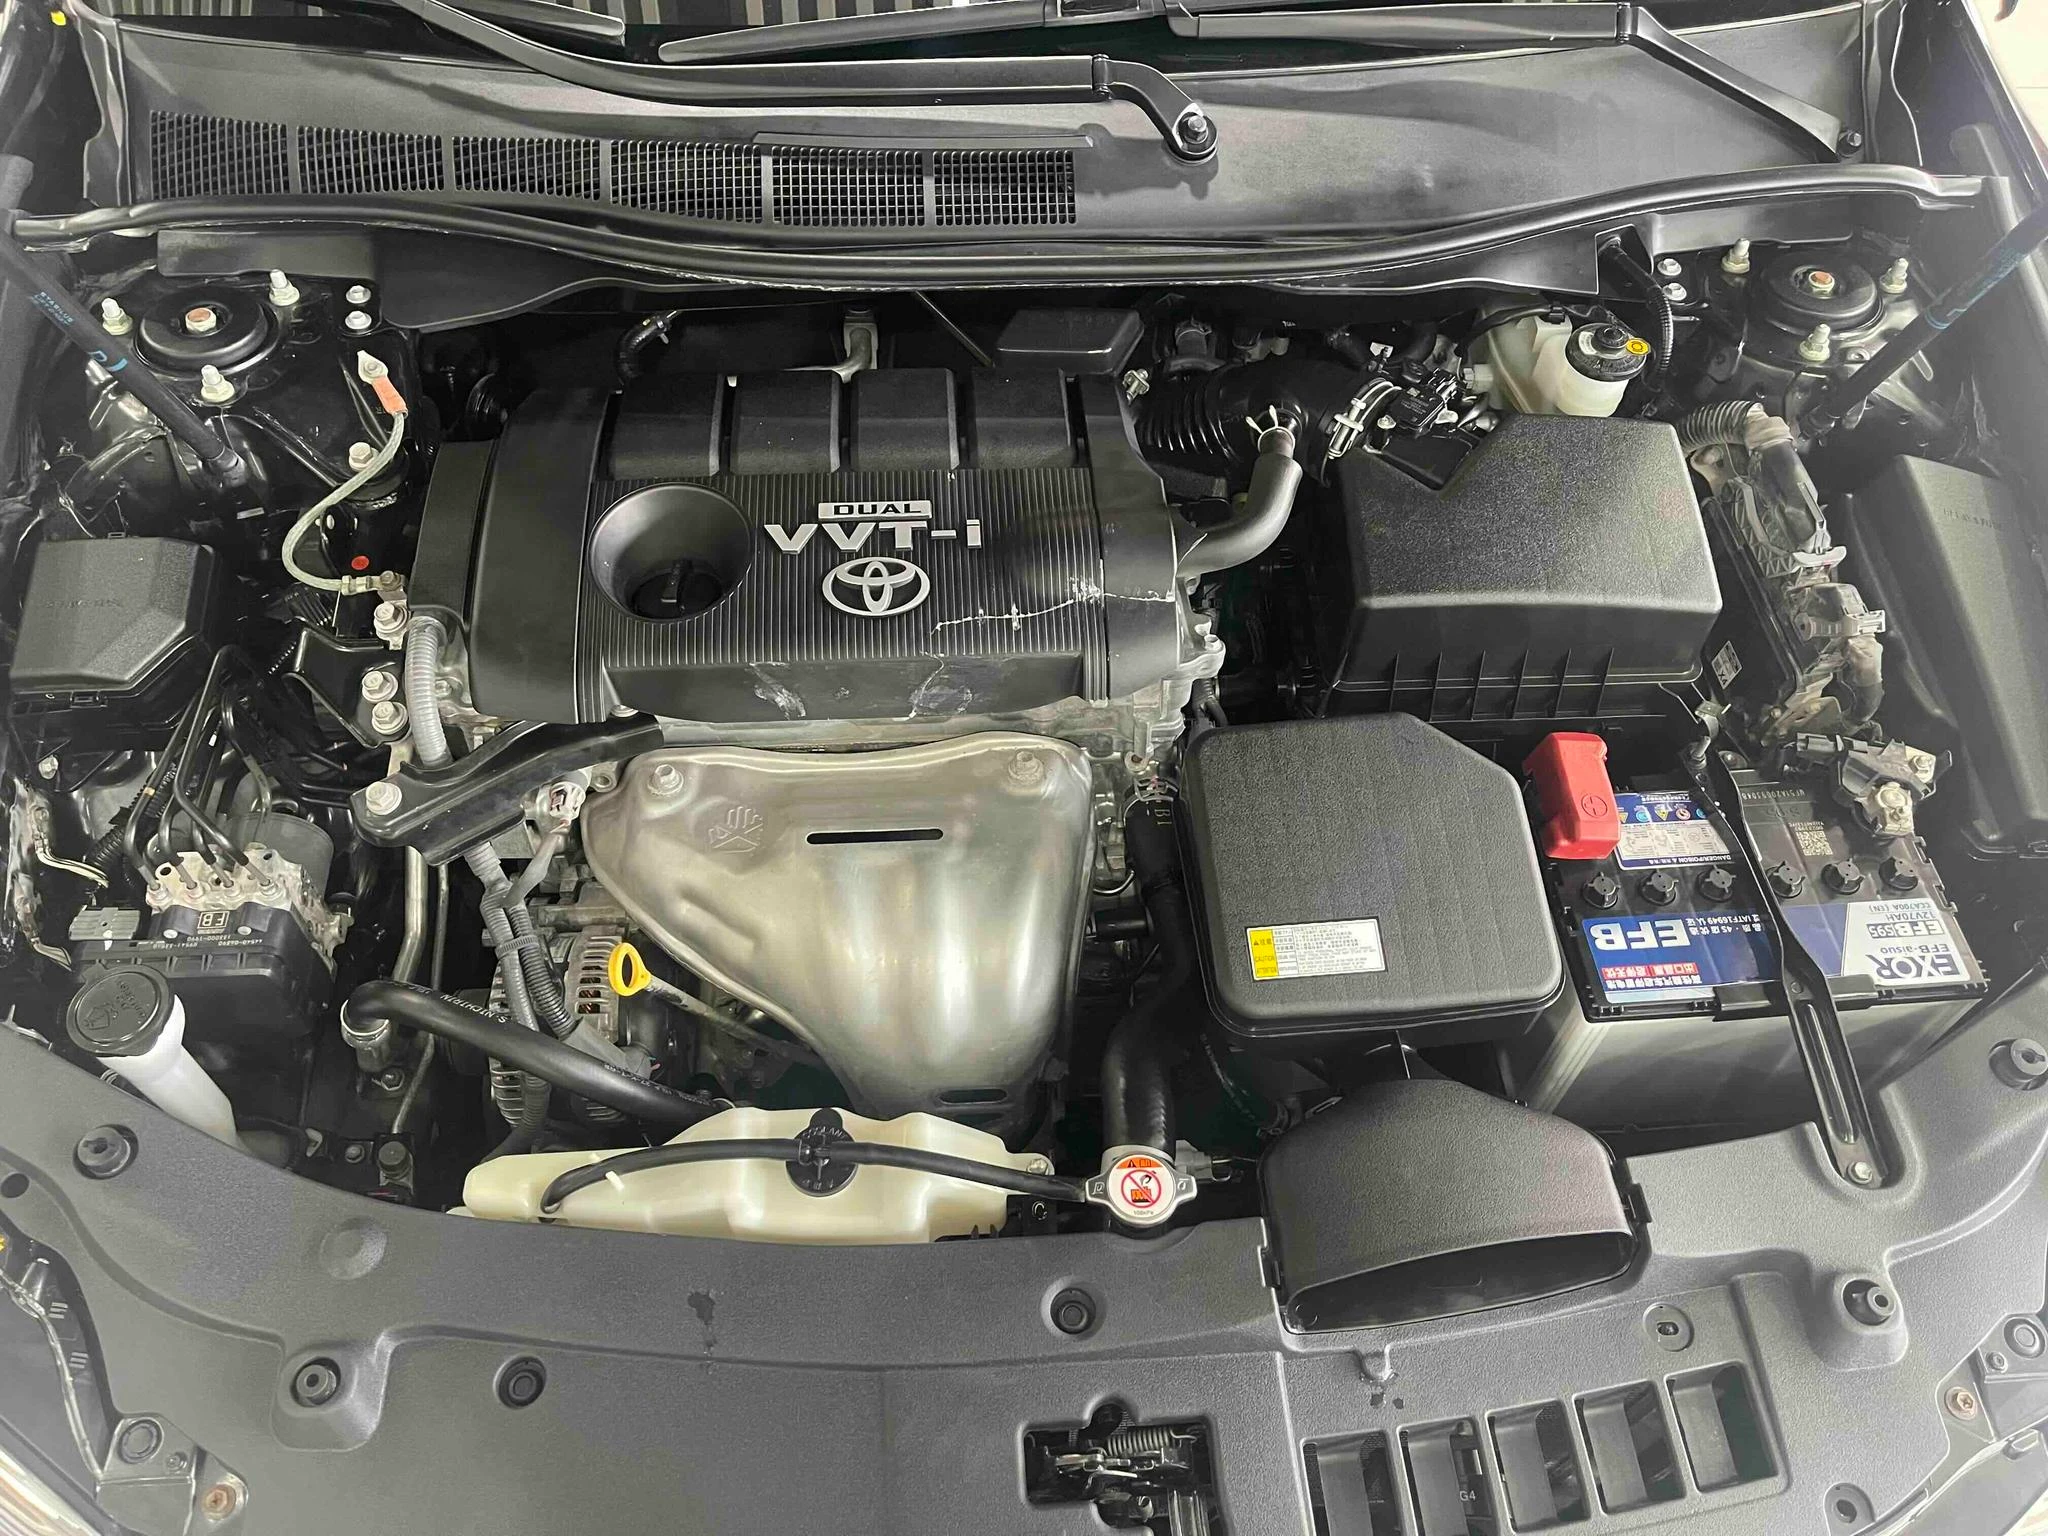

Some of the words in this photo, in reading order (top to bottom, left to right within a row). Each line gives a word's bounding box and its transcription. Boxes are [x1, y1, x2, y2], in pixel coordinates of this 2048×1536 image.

[833, 503, 922, 515] DUAL
[763, 519, 982, 554] VVT-i
[203, 913, 226, 927] FB
[1885, 911, 1936, 921] 12V70AH
[1894, 919, 1945, 935] EFB
[1589, 919, 1691, 951] EFB
[1865, 953, 1961, 980] EXOR
[1459, 1490, 1476, 1502] G4
